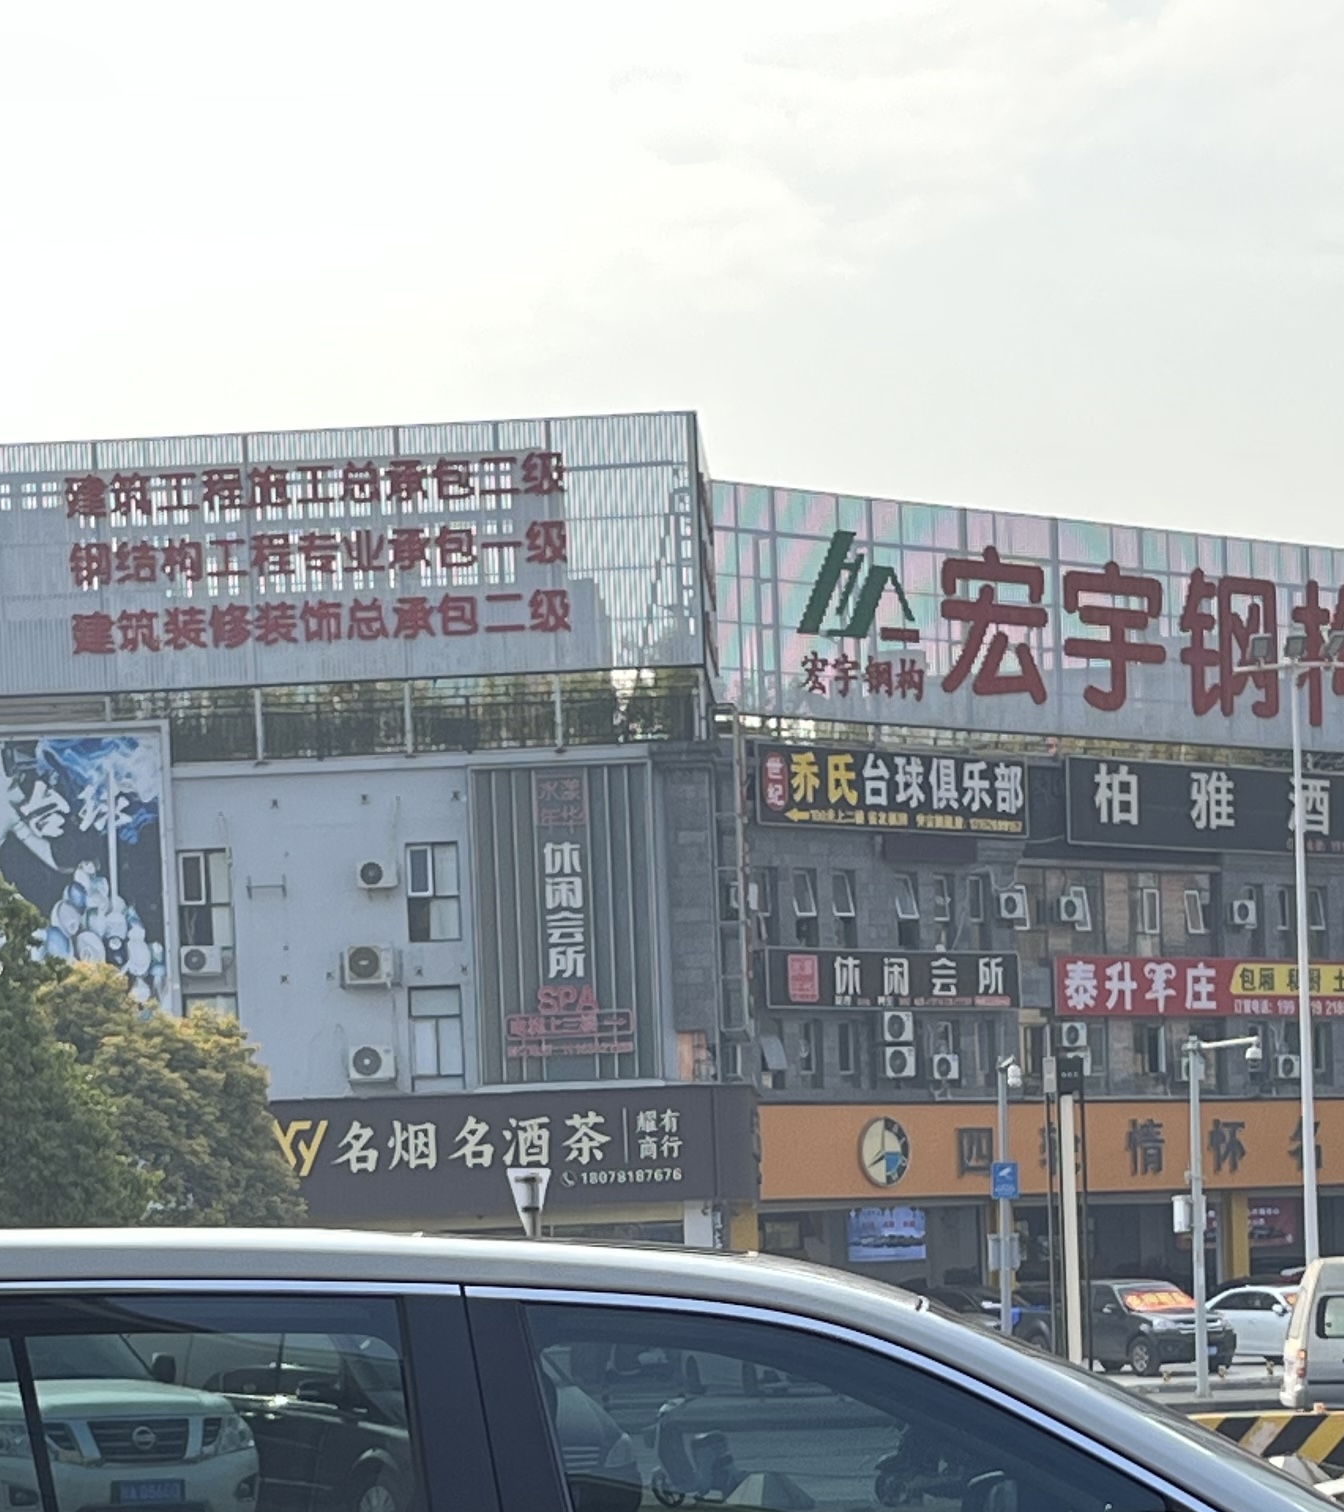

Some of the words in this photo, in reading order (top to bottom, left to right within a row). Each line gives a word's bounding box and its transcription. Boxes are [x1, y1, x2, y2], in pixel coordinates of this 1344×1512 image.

[69, 520, 568, 588] 钢结构工程专业承包一级
[71, 589, 572, 655] 建筑装修装饰总承包二级
[800, 650, 925, 702] 宏宇钢构
[790, 751, 1025, 815] 乔氏台球俱乐部
[543, 841, 586, 979] 休闲会所
[537, 984, 599, 1014] SPA
[834, 956, 1004, 997] 休闲会所
[331, 1110, 612, 1173] 名烟名酒茶
[580, 1167, 683, 1186] 18078187676
